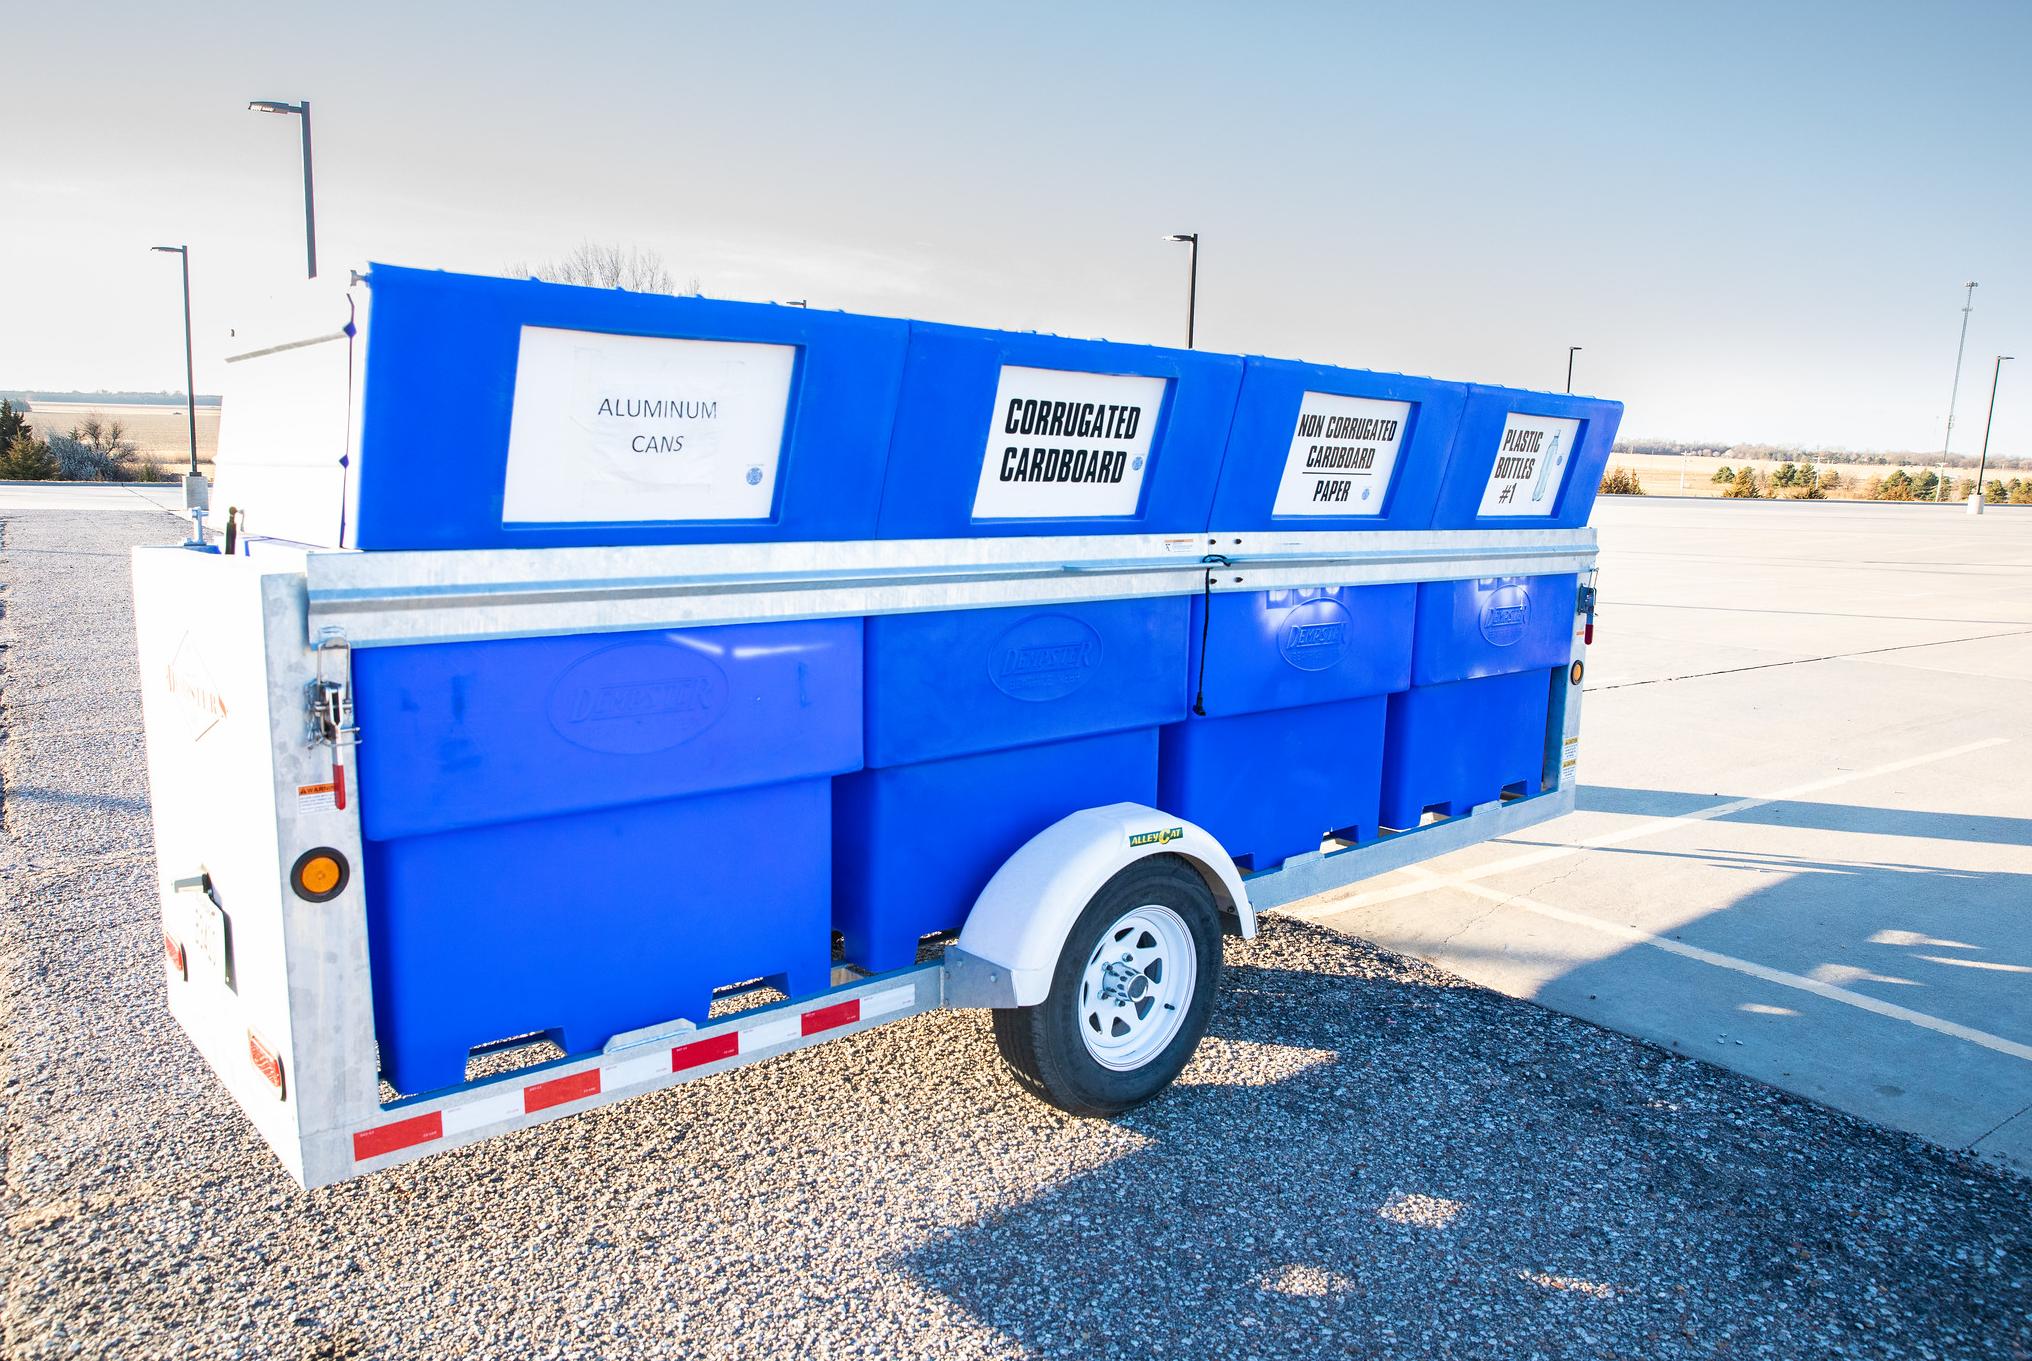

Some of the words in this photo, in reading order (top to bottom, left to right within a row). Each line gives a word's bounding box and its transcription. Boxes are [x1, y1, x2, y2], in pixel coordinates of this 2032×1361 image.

[597, 398, 717, 419] ALUMINUM
[1004, 398, 1141, 439] CORRUGATED
[1297, 414, 1326, 438] NON
[1325, 415, 1398, 442] CORRUGATED
[631, 435, 684, 453] CANS
[1502, 429, 1544, 453] PLASTIC
[999, 447, 1127, 483] CARDBOARD
[1305, 445, 1376, 469] CARDBOARD
[1494, 456, 1536, 480] BOTTLES
[1312, 480, 1352, 502] PAPER
[1498, 482, 1517, 504] #1
